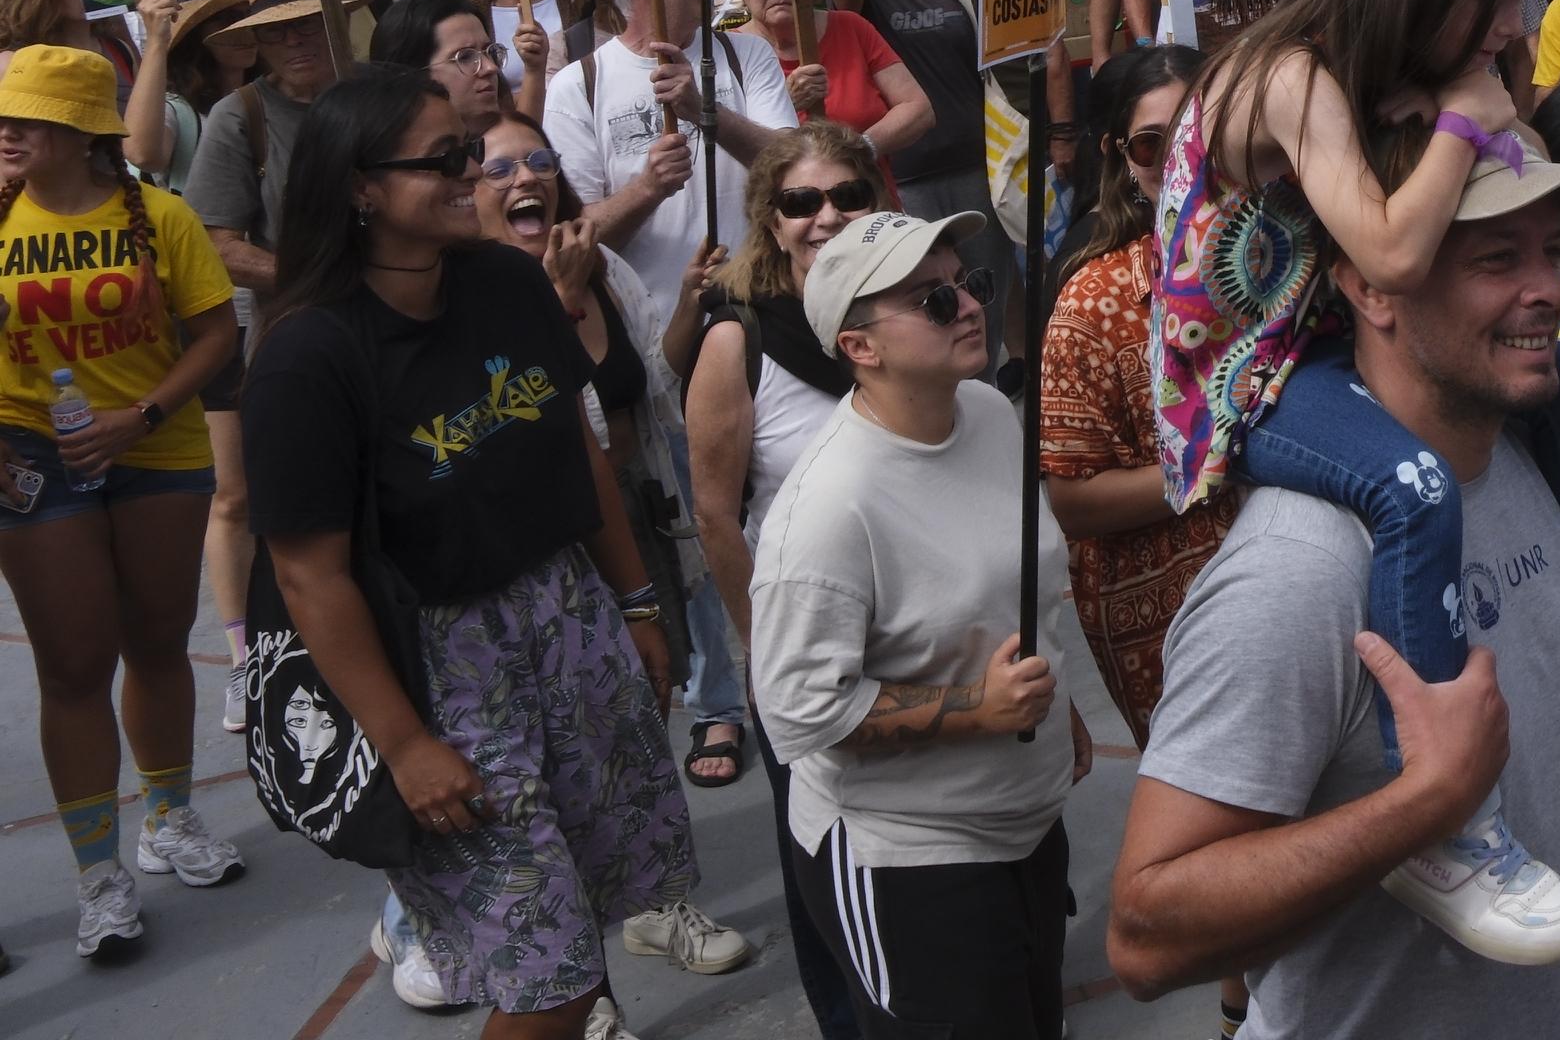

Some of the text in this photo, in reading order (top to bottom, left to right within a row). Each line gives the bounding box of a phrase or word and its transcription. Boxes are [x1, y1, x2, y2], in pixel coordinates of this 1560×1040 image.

[17, 272, 137, 326] NO
[7, 329, 40, 365] SE
[1504, 544, 1549, 588] UNR
